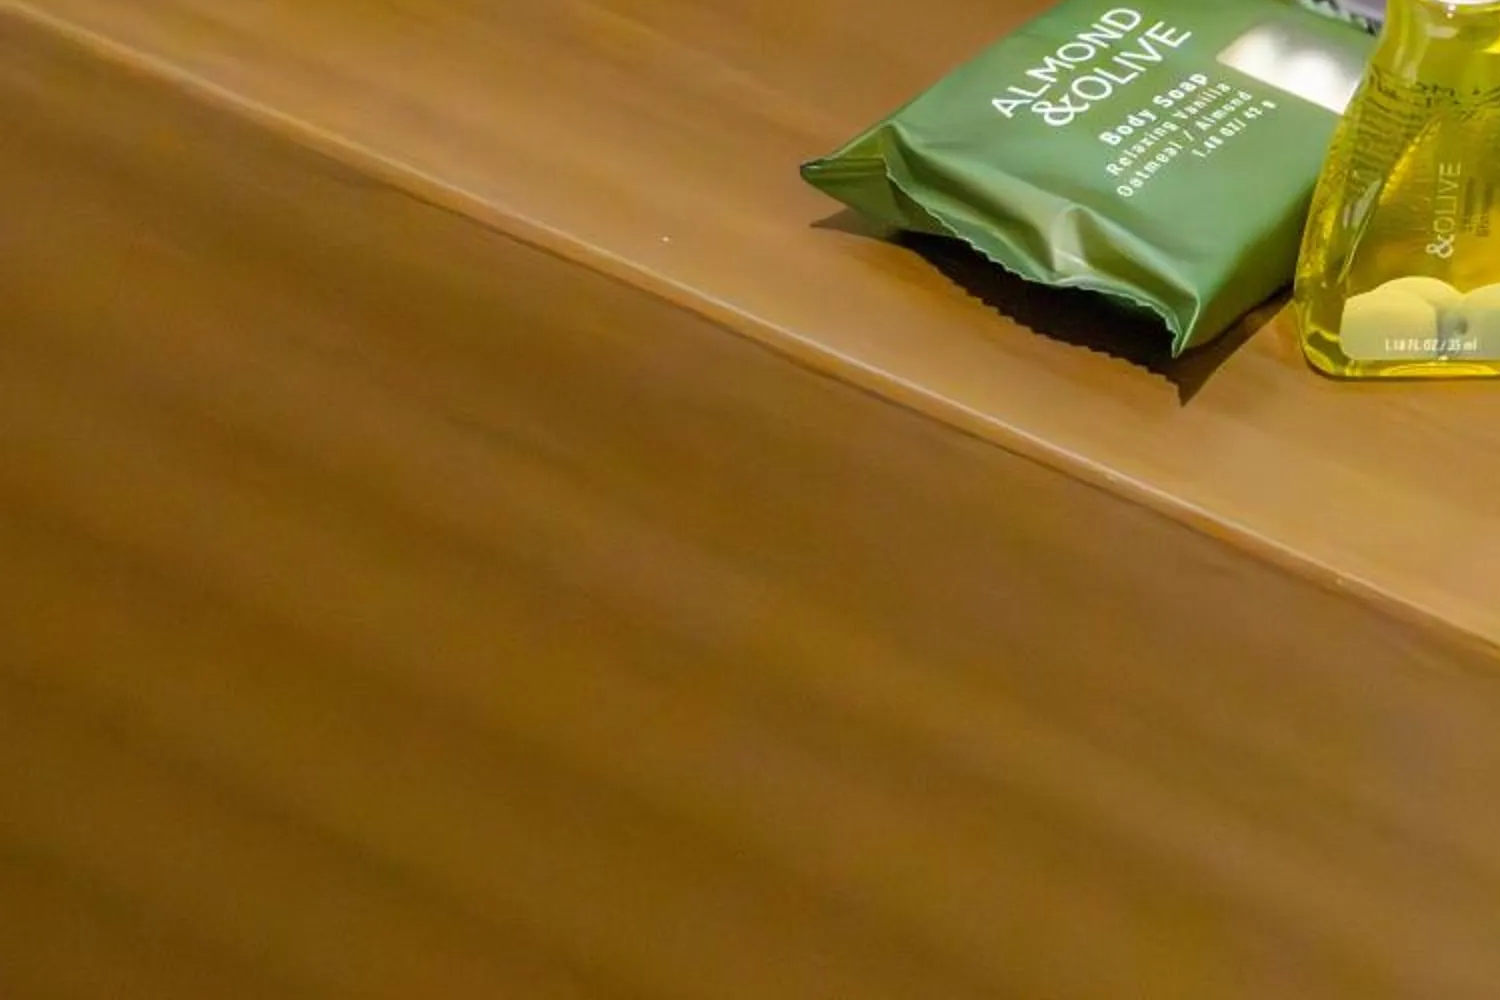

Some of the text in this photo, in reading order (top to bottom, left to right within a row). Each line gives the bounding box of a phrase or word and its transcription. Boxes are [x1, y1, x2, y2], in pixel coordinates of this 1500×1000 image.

[991, 7, 1143, 119] ALMOND
[1031, 21, 1192, 127] &OLIVE
[1099, 73, 1208, 146] Body Soap
[1106, 82, 1232, 176] Relaxing Vanilla
[1116, 141, 1183, 197] Oatmeal
[1195, 90, 1253, 131] Almond
[1425, 162, 1462, 259] &OLIVE
